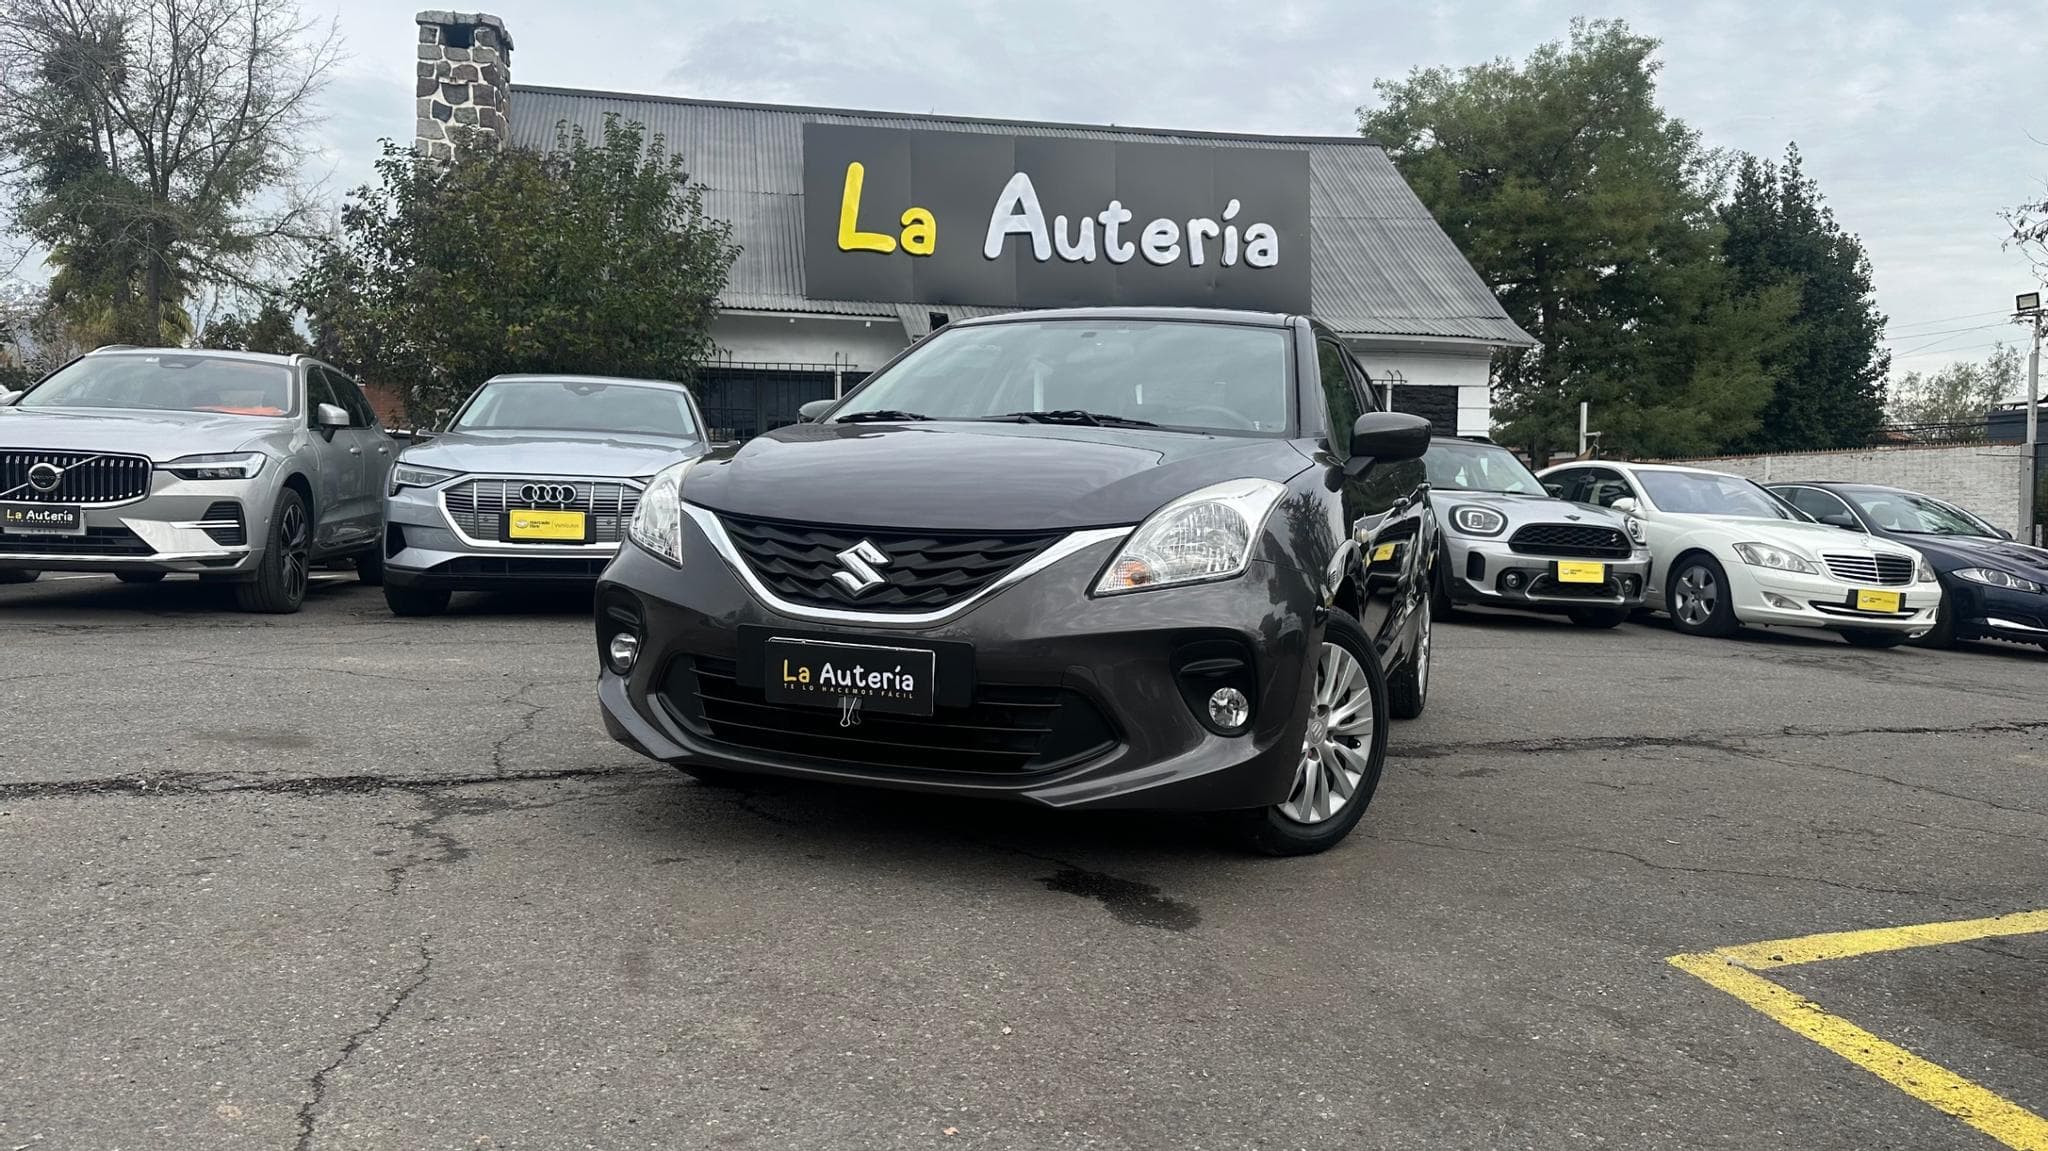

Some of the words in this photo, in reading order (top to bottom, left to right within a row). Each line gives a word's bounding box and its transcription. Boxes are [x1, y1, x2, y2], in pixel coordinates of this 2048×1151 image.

[837, 162, 937, 256] La
[983, 171, 1280, 268] Autería
[6, 509, 22, 519] La
[26, 509, 74, 520] Autería
[783, 658, 811, 683] La
[819, 662, 914, 691] Autería
